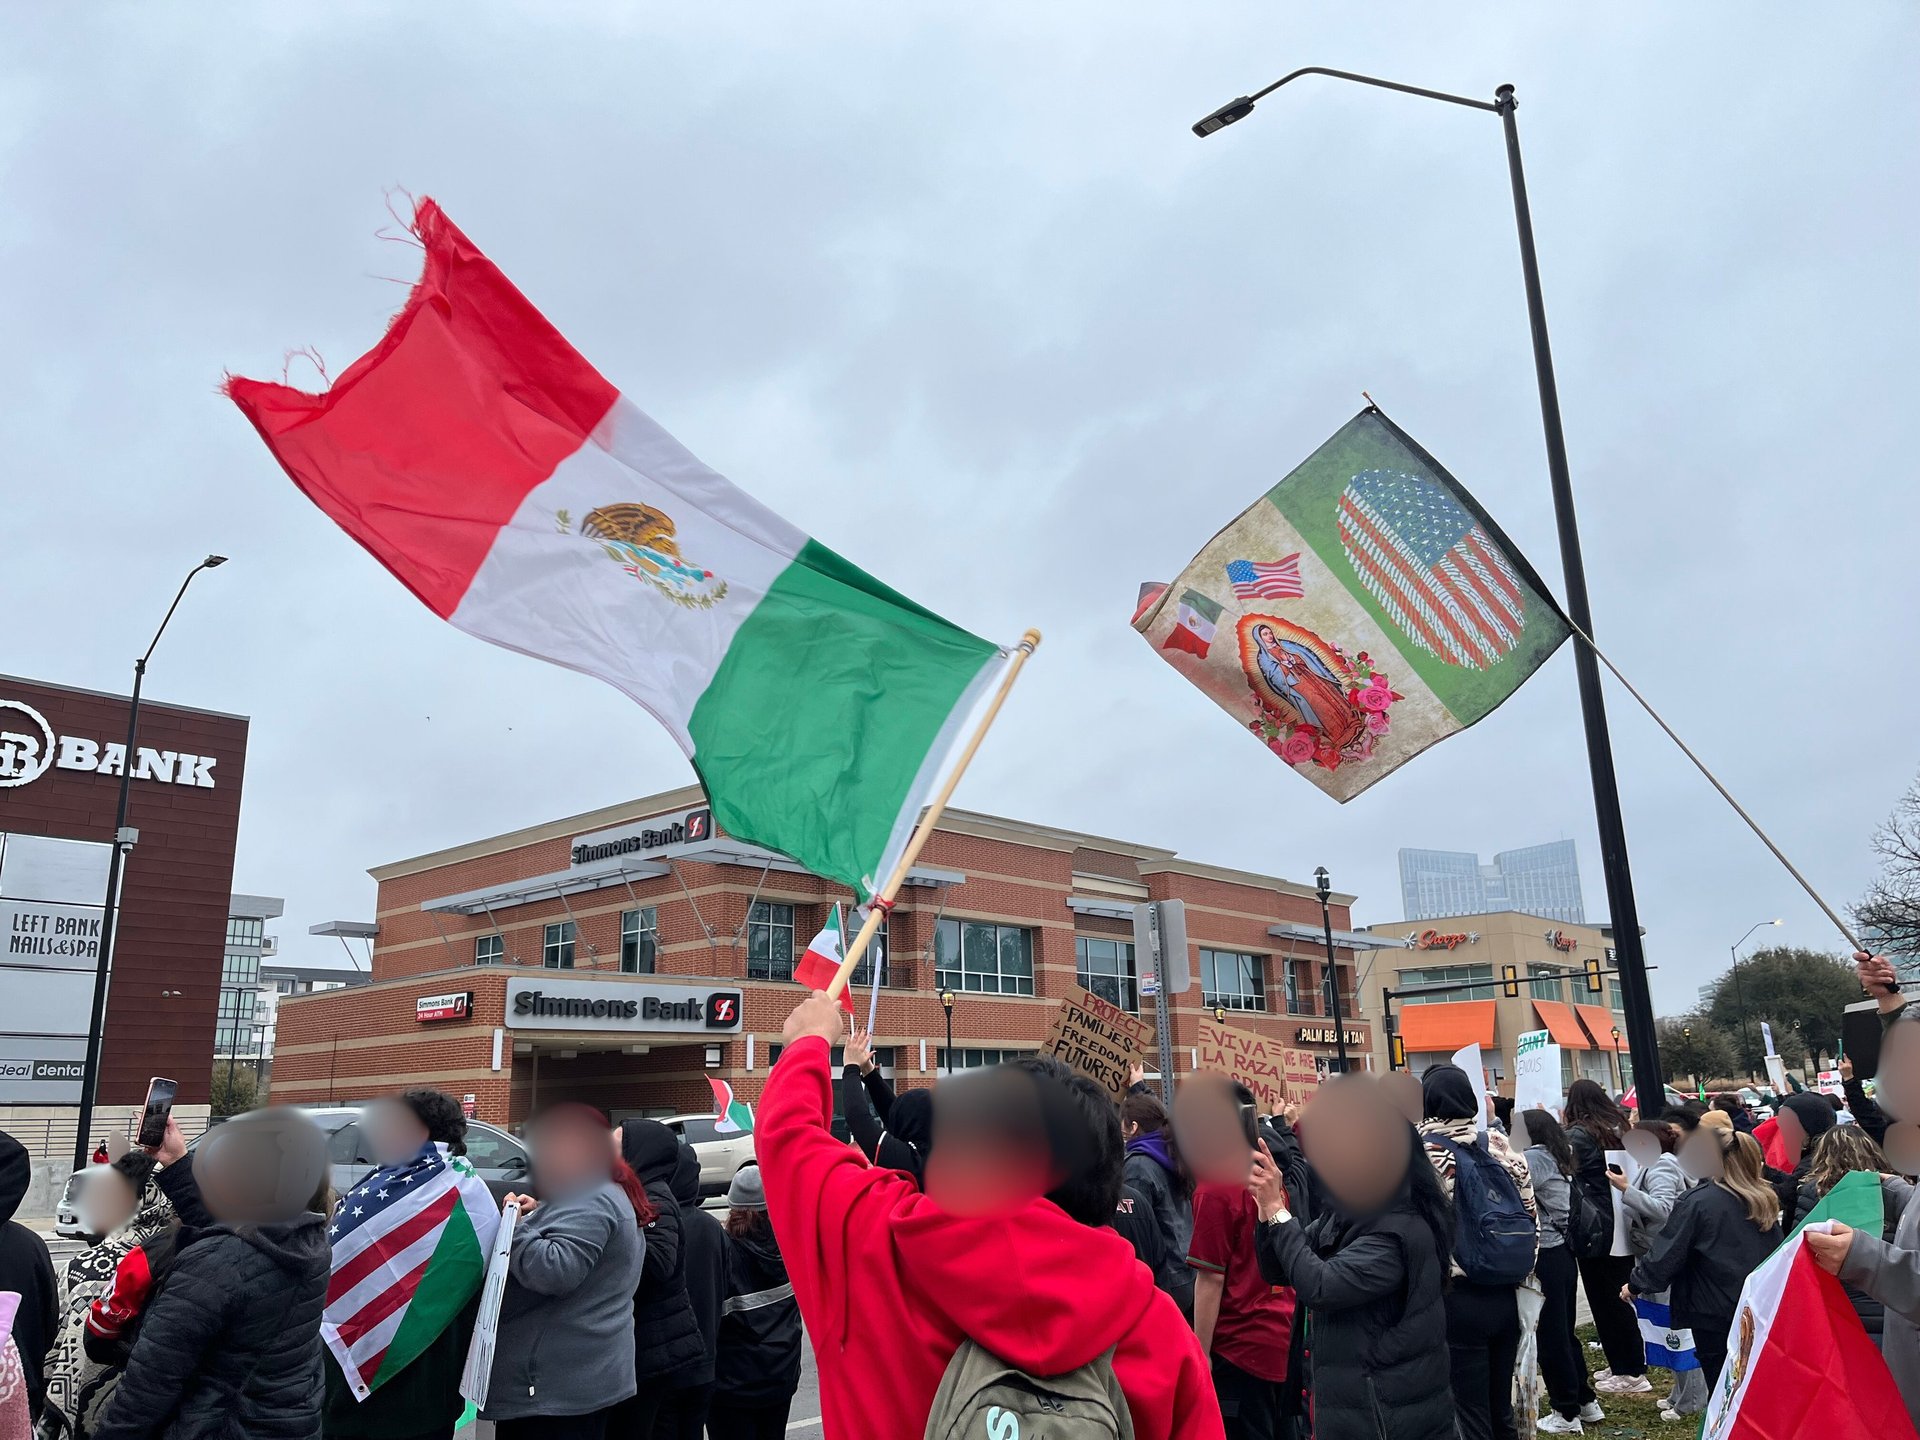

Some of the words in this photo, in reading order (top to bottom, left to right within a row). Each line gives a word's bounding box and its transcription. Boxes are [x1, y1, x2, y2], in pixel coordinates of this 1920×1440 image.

[56, 735, 217, 789] BANK
[571, 836, 641, 865] Simmons
[641, 822, 685, 849] Bank
[12, 913, 50, 934] LEFT
[54, 916, 101, 937] BANK
[1417, 928, 1467, 950] Snooze
[418, 1000, 440, 1009] Simmons
[441, 998, 454, 1007] Bank
[434, 1010, 444, 1018] ATM
[514, 991, 638, 1019] Simmons
[642, 996, 704, 1021] Bank
[1082, 992, 1148, 1039] PROTECT
[1061, 1025, 1128, 1072] FREEDOM
[1210, 1029, 1267, 1059] VIVA
[1301, 1027, 1323, 1042] PALM
[1324, 1029, 1349, 1043] BEAH
[1350, 1031, 1365, 1044] TAN
[36, 1063, 85, 1077] dental
[1053, 1039, 1123, 1093] FUTURES
[1202, 1047, 1226, 1066] LA
[1234, 1053, 1280, 1081] RAZA
[1284, 1050, 1297, 1067] WE
[1299, 1052, 1315, 1070] ARE
